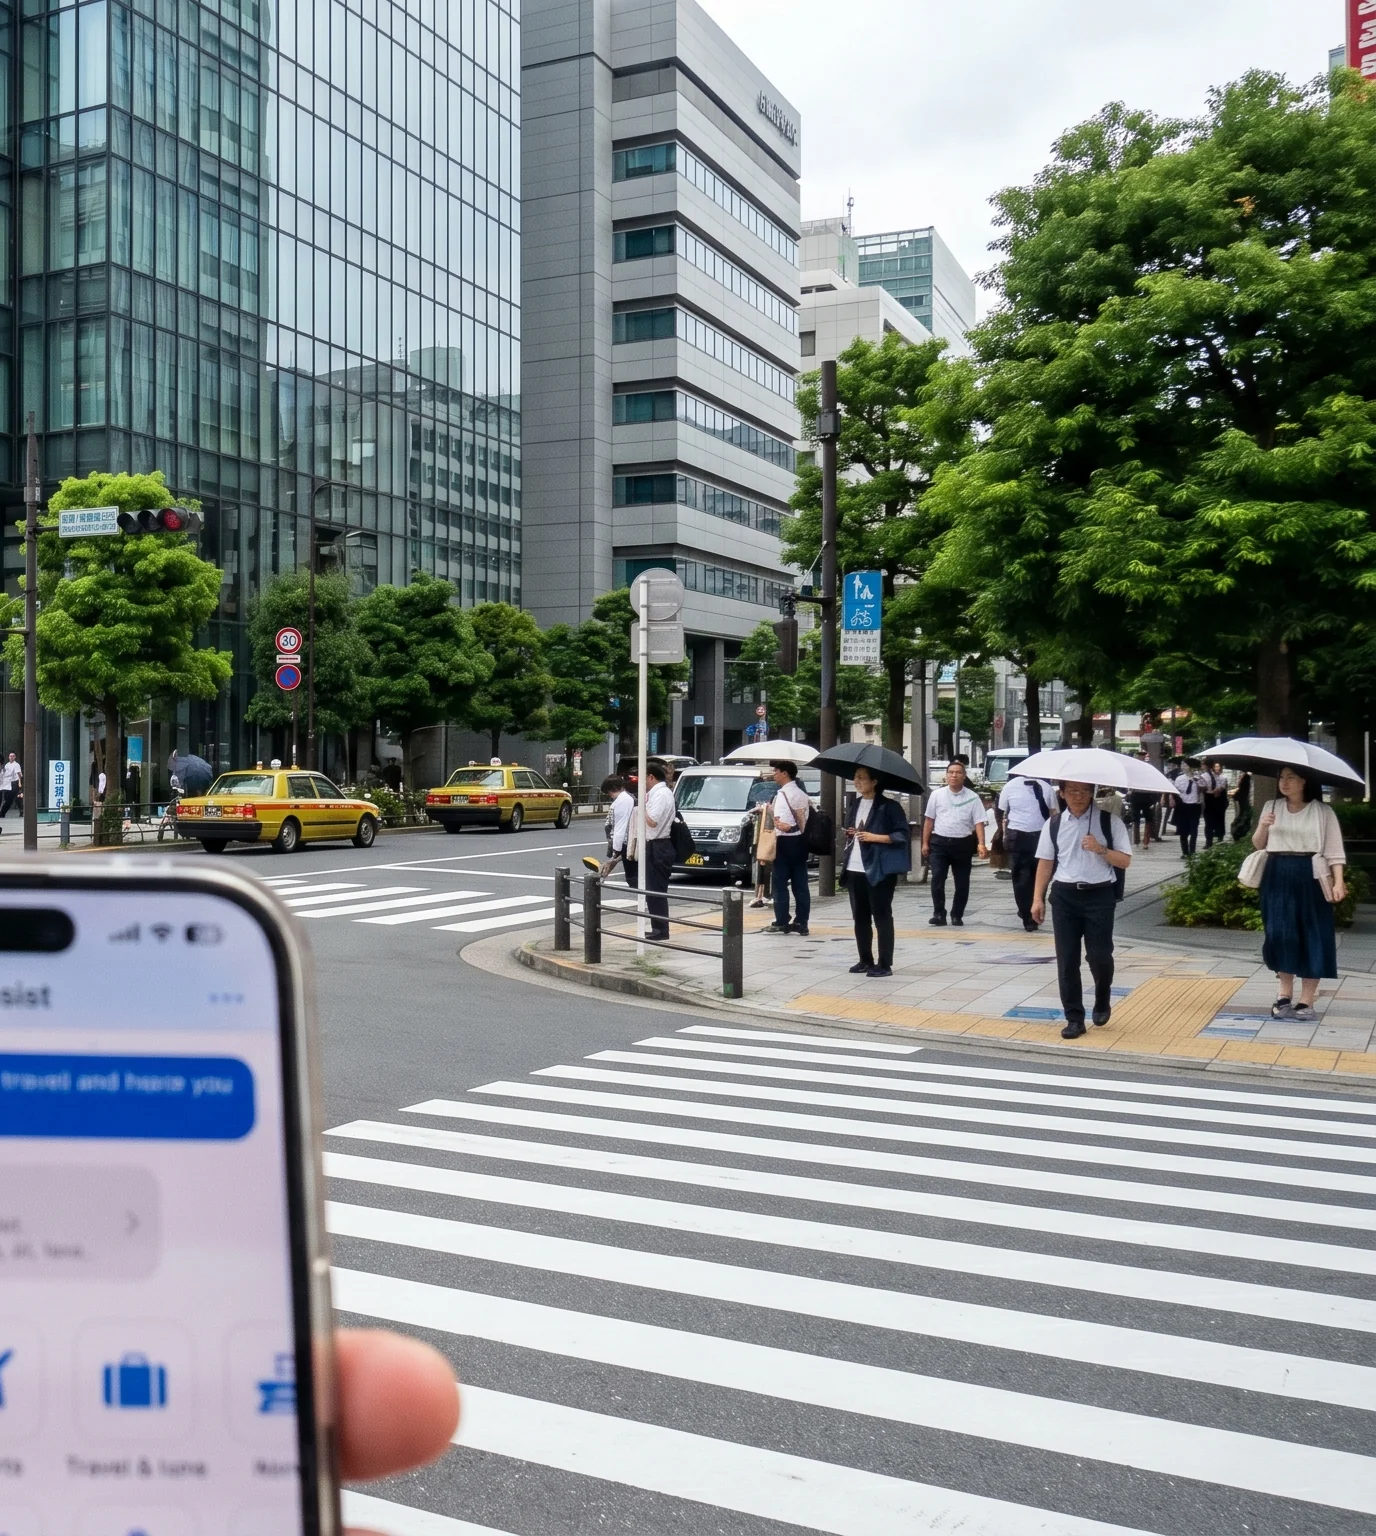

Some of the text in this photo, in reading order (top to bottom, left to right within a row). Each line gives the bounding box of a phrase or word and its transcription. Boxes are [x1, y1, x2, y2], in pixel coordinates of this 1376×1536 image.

[282, 636, 296, 647] 30
[77, 1070, 120, 1092] and
[66, 1454, 131, 1478] Travel
